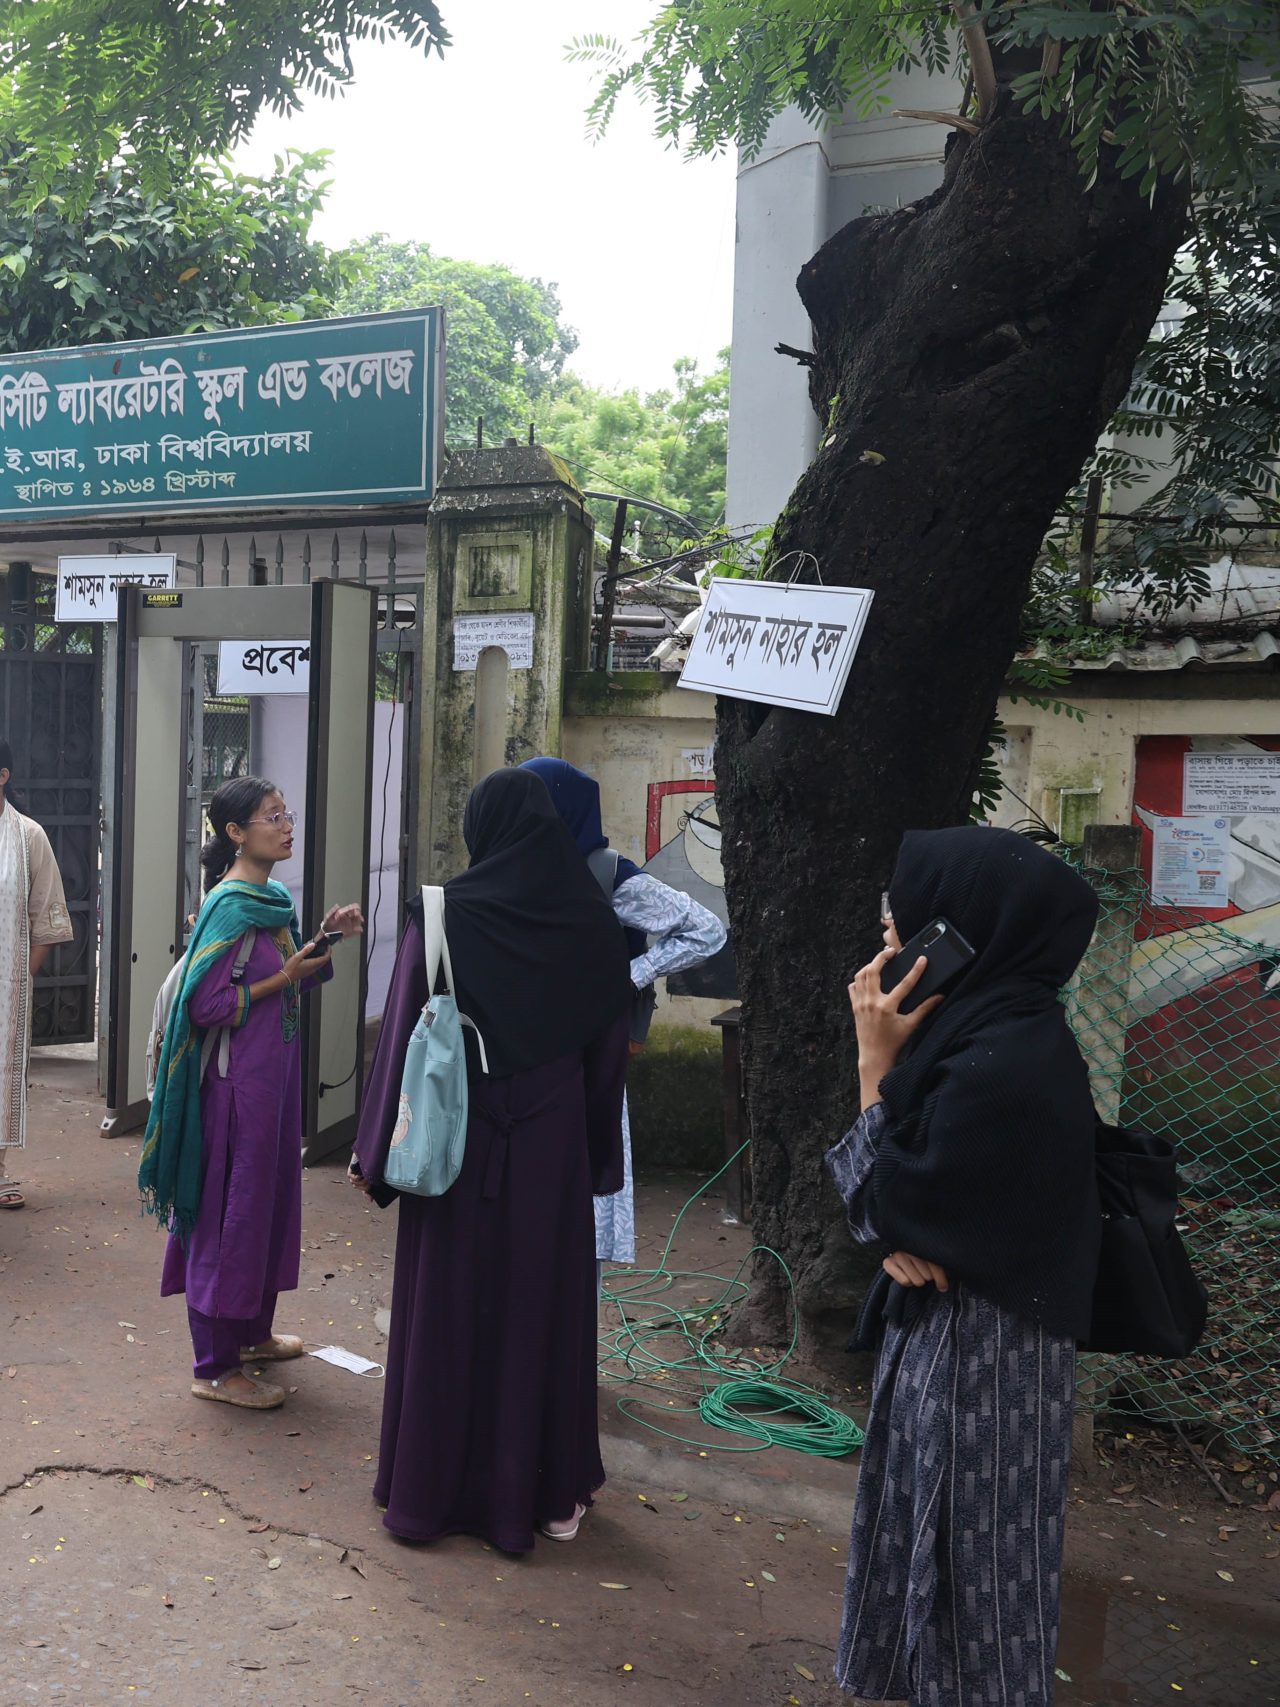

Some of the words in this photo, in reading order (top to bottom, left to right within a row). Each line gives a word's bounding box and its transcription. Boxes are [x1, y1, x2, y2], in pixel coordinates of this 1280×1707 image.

[55, 358, 188, 425] ল্যাবরেটরি
[192, 366, 248, 427] স্কুল
[257, 360, 311, 408] এন্ড
[315, 349, 416, 403] কলেজ
[93, 440, 151, 466] ঢাকা
[157, 430, 313, 463] বিশ্ববিদ্যালয়
[13, 478, 75, 503] স্থাপিত
[100, 477, 155, 496] ১৯৬৪
[163, 468, 237, 494] খ্রিস্টাব্দ
[63, 573, 106, 608] শামসুন
[147, 594, 178, 602] GARRETT
[704, 605, 762, 672] শামসুন
[759, 613, 813, 669] নাহার
[811, 623, 848, 674] হল
